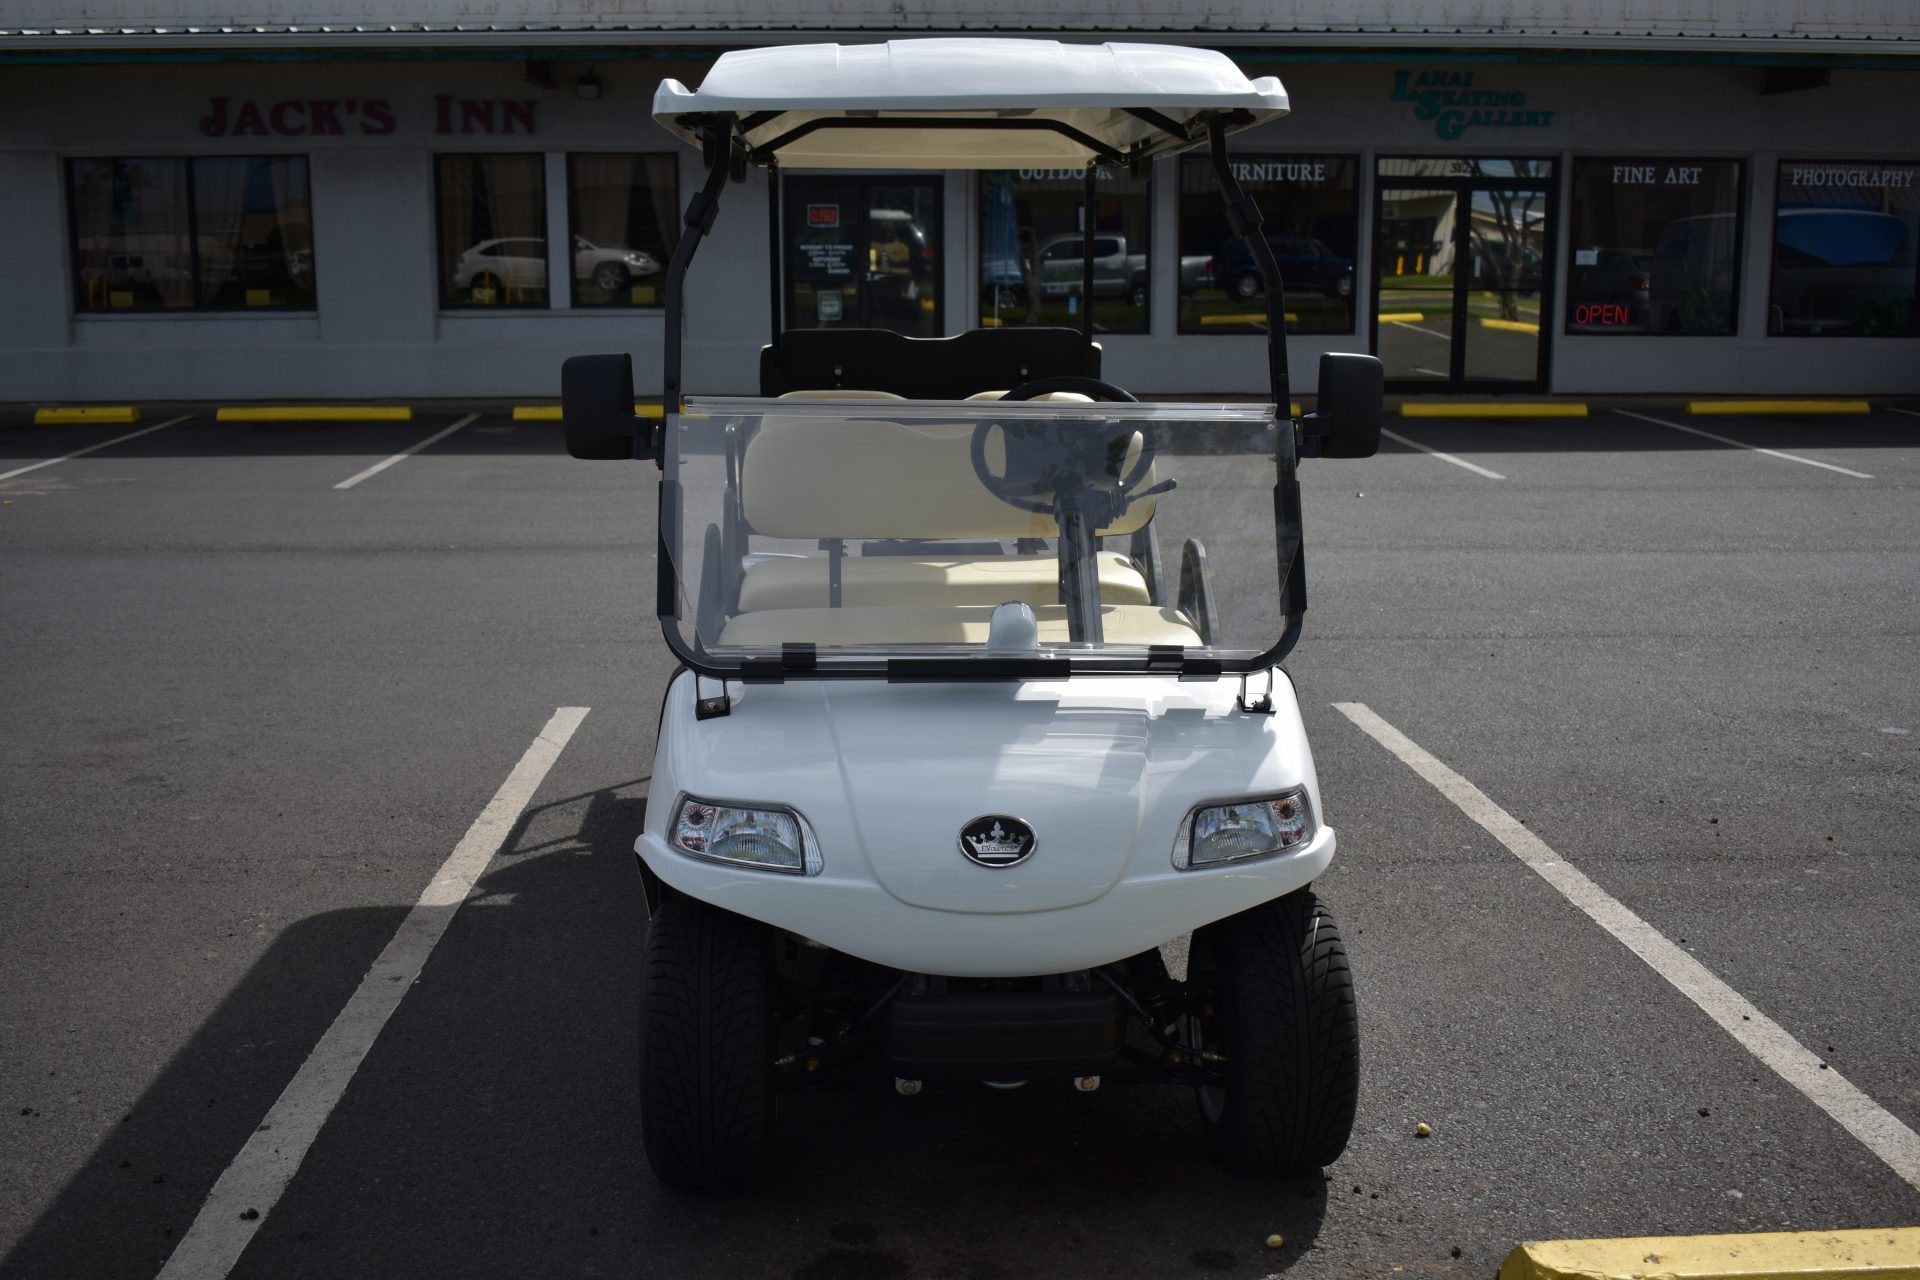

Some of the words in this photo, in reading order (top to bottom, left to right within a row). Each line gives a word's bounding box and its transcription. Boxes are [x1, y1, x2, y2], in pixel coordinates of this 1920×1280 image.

[1391, 70, 1474, 101] LANAI
[199, 97, 397, 137] JACK'S
[433, 95, 538, 135] INN
[1414, 90, 1526, 121] SEATING
[1437, 109, 1556, 141] GALLERY
[1612, 166, 1656, 184] FINE
[1664, 166, 1702, 185] ART
[1792, 168, 1914, 188] PHOTOGRAPHY
[1575, 304, 1630, 325] OPEN
